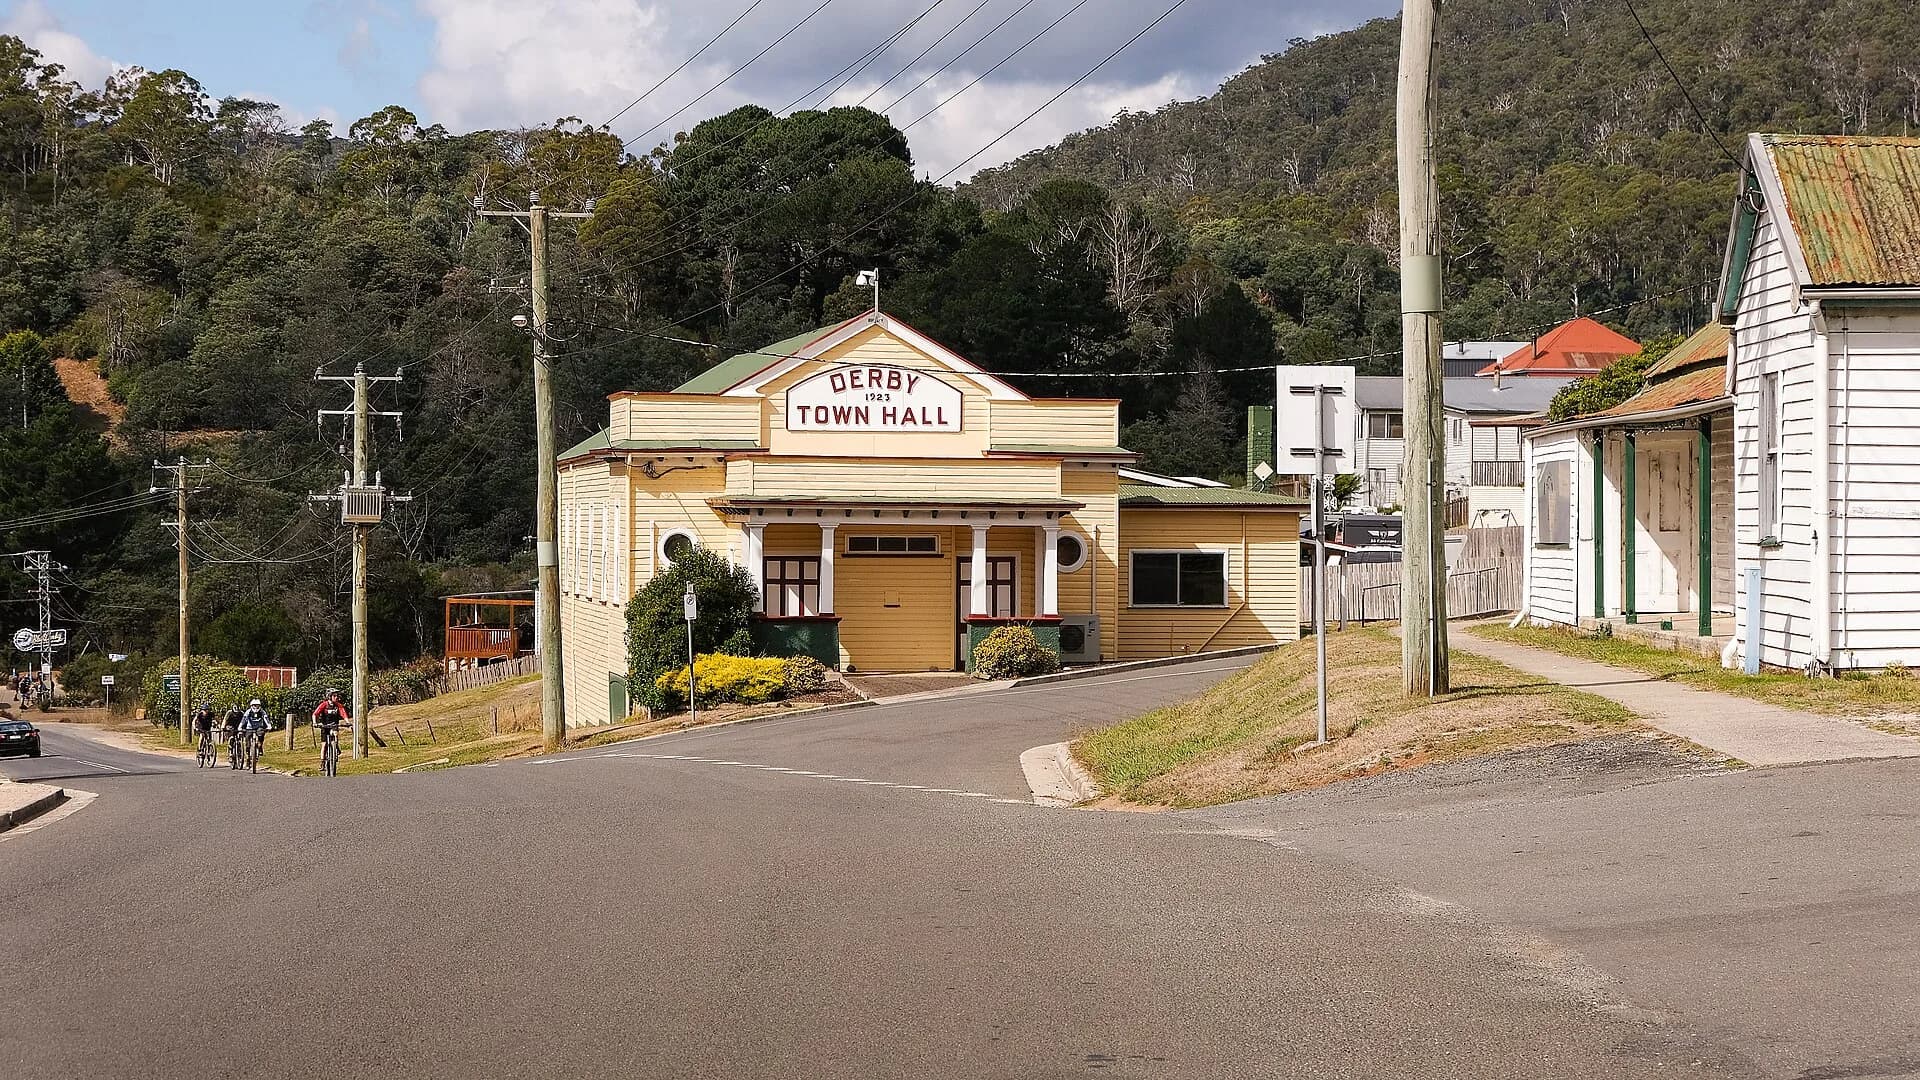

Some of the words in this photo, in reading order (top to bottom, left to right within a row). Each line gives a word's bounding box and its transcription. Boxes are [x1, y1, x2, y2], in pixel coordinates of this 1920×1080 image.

[829, 368, 920, 394] DERBY
[865, 392, 891, 402] 1923
[796, 405, 870, 425] TOWN
[882, 406, 949, 426] HALL
